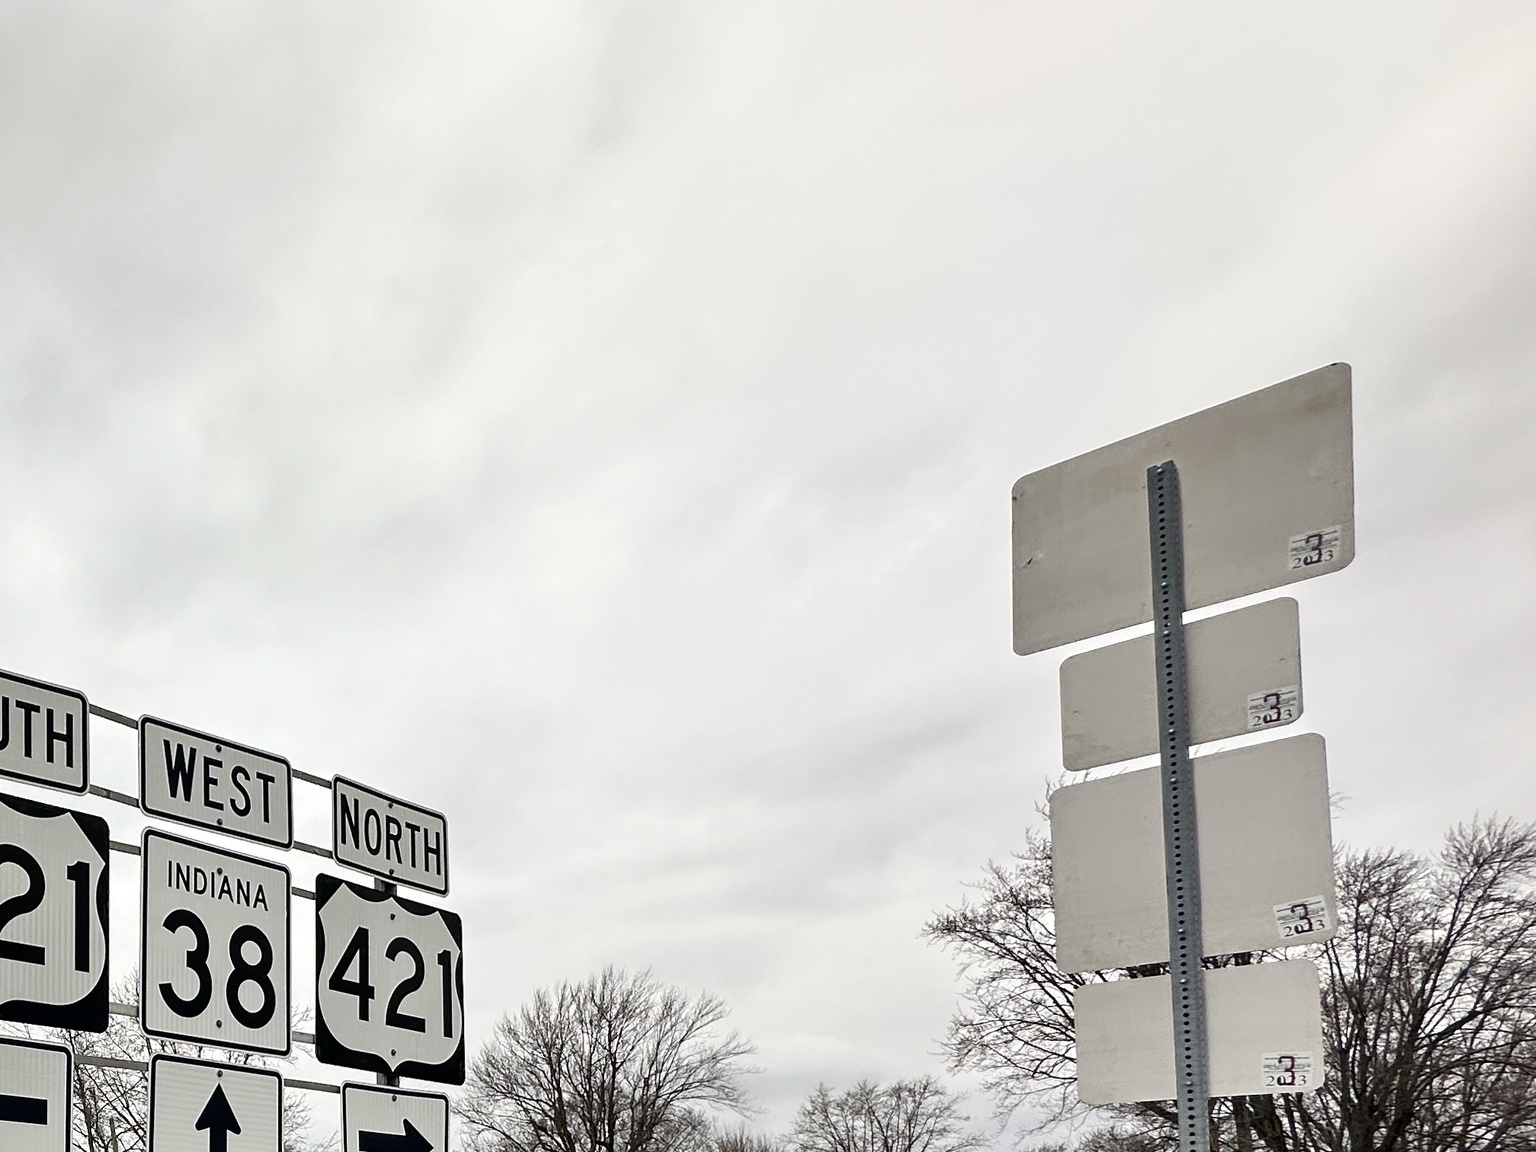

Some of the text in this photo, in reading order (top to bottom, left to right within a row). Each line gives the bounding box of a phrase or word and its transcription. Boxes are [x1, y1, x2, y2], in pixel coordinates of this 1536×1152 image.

[163, 738, 276, 825] WEST
[340, 793, 442, 876] NORTH
[167, 859, 269, 912] INDIANA
[158, 908, 276, 1030] 38
[328, 926, 454, 1039] 421
